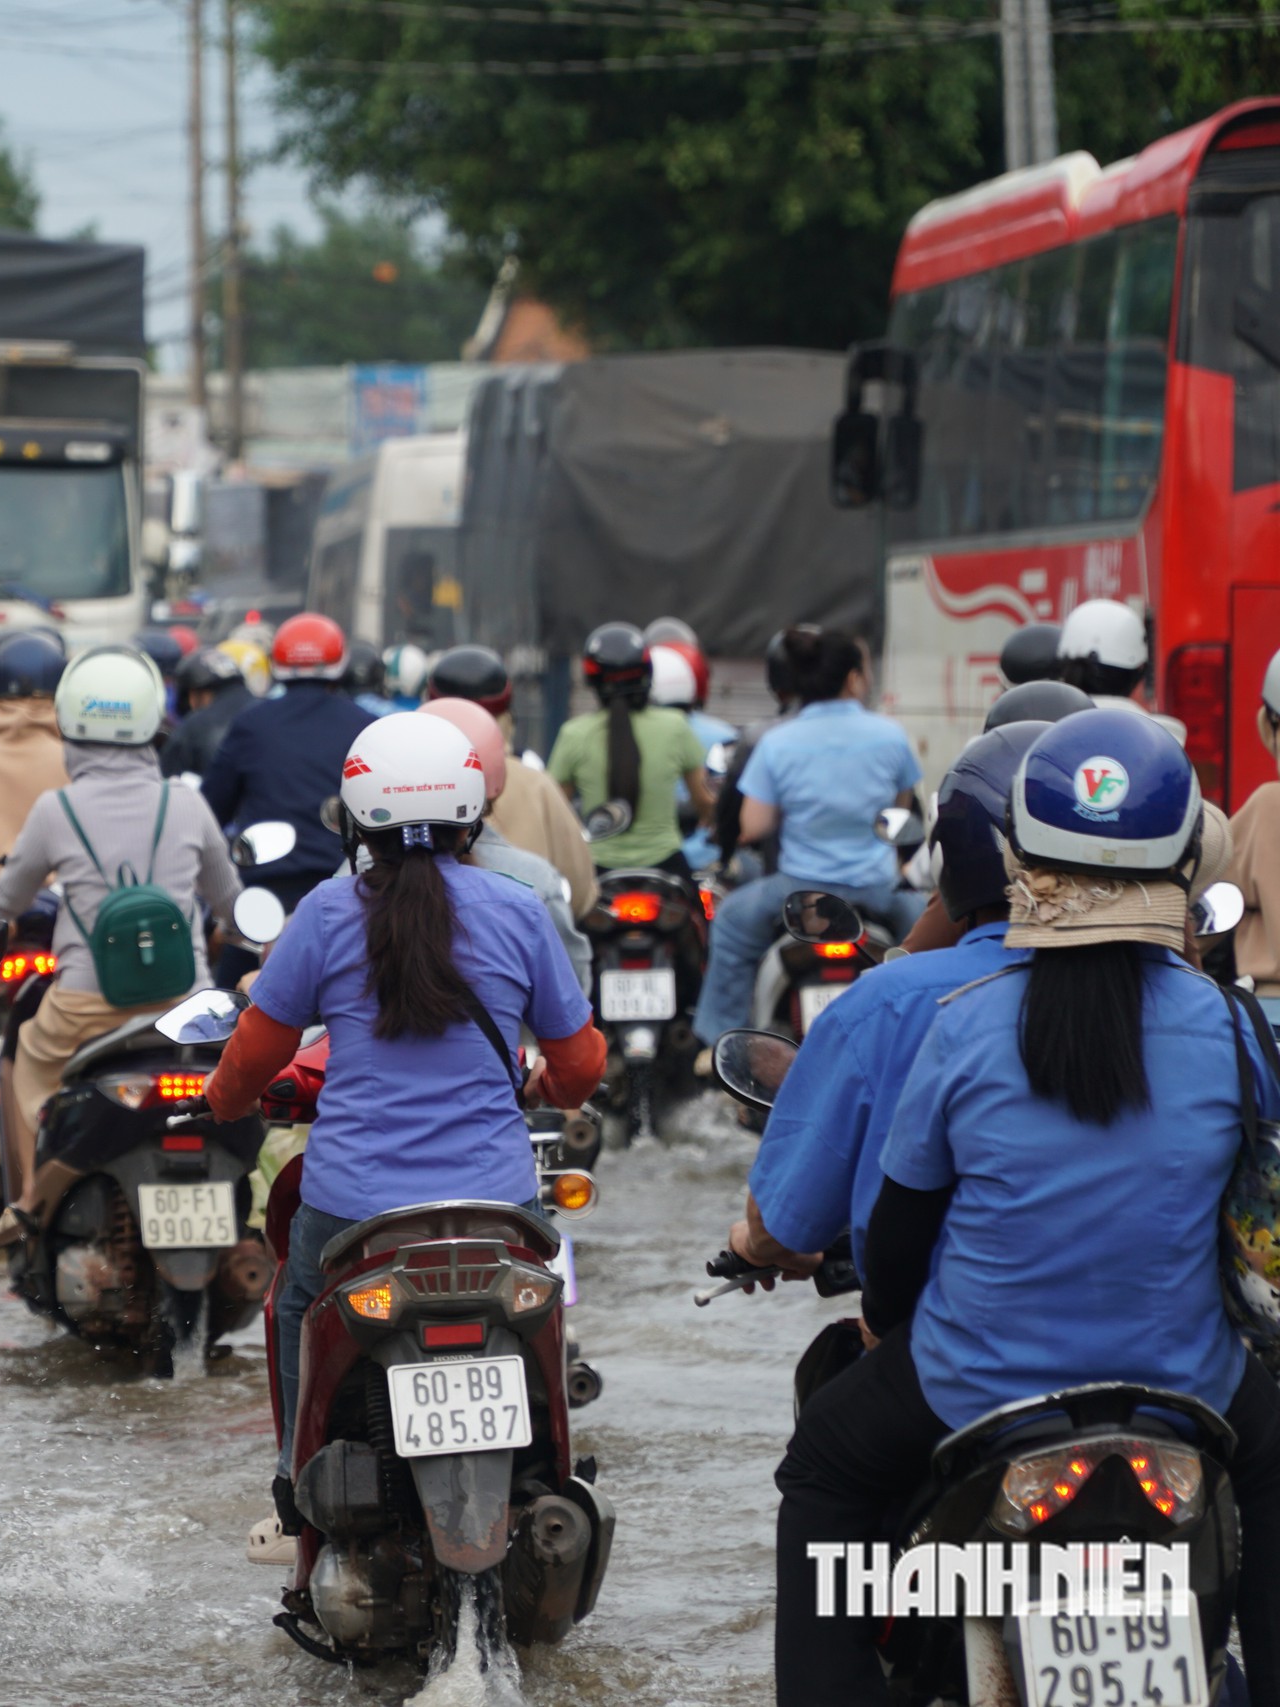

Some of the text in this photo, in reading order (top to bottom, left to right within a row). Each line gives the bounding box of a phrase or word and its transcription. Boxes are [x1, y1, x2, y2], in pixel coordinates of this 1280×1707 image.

[154, 1188, 217, 1214] 60-F1
[148, 1217, 230, 1243] 990.25
[433, 1354, 474, 1362] HONDA
[412, 1366, 503, 1406] 60-B9
[405, 1405, 518, 1448] 485.87
[1051, 1605, 1170, 1657] 60-B9
[1039, 1655, 1192, 1707] 295.41
